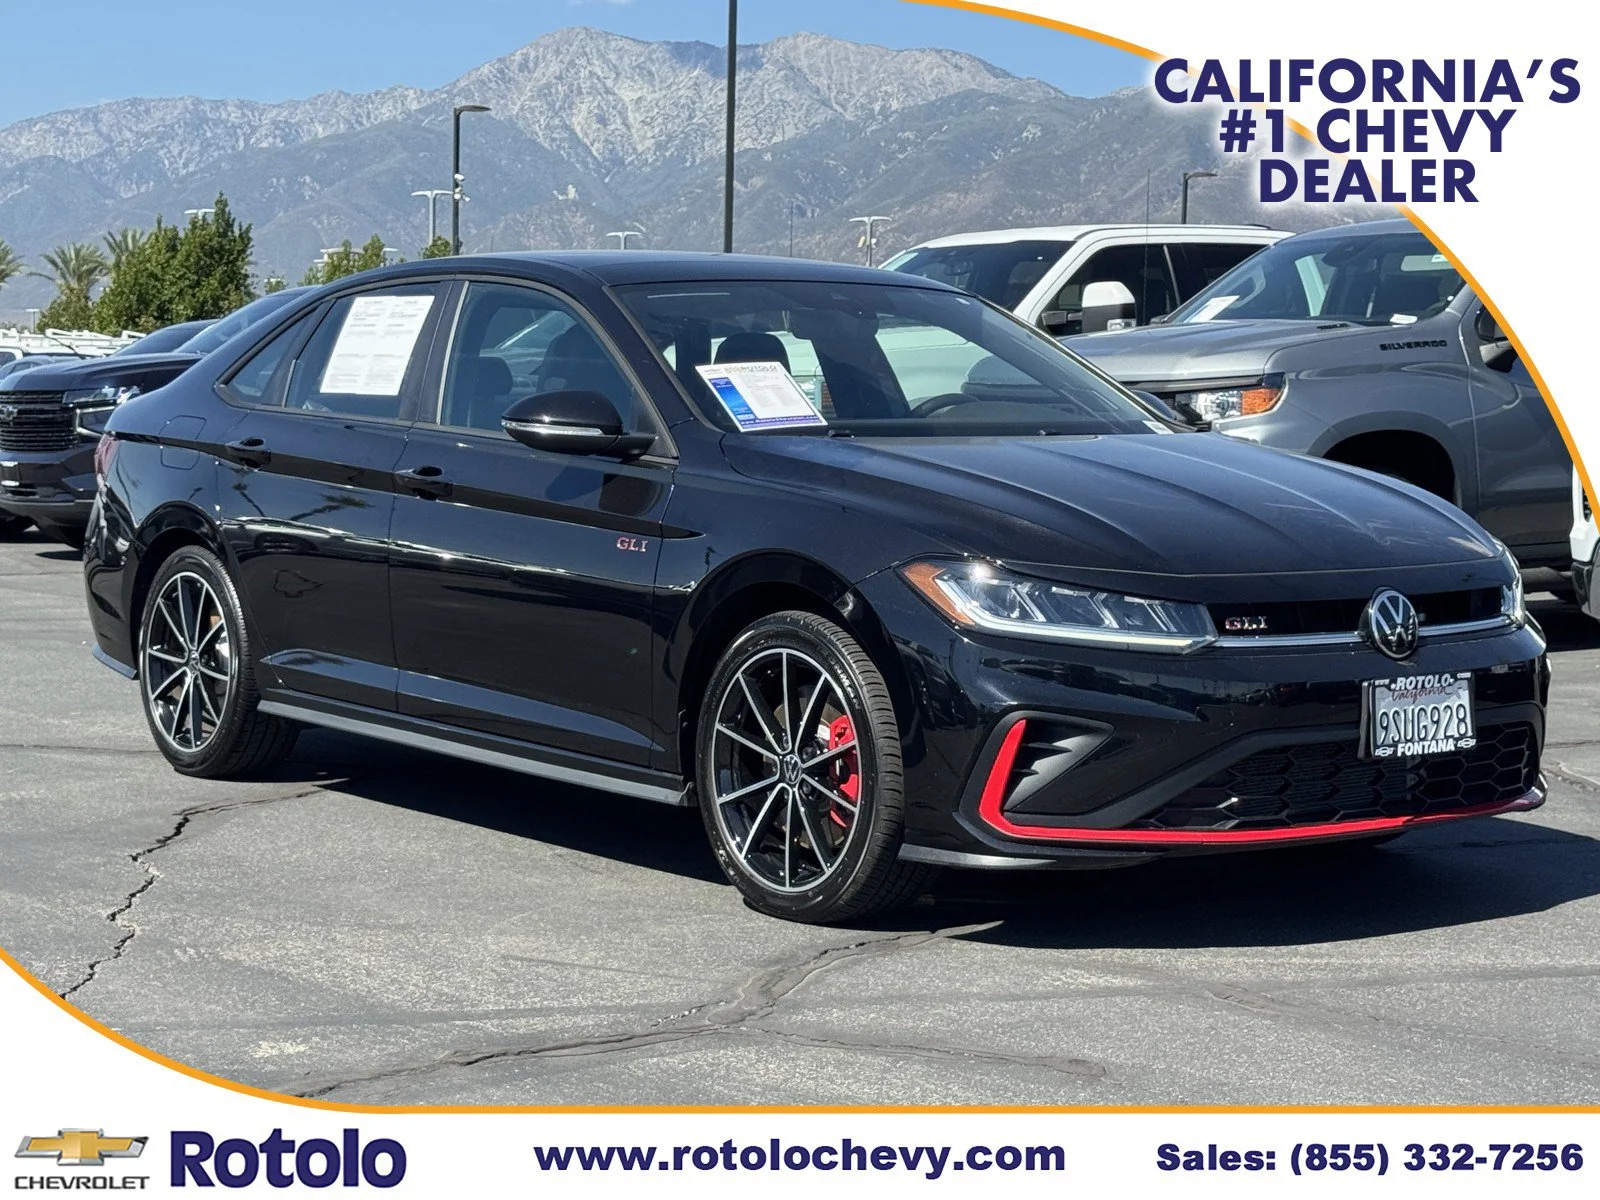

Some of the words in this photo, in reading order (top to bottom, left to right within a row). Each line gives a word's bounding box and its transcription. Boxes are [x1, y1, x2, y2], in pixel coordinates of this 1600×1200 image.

[1379, 339, 1448, 352] SILVERADO
[616, 536, 649, 553] GLI
[1224, 615, 1268, 631] GLI
[1395, 673, 1452, 691] ROTOLO
[1378, 701, 1468, 746] 9SUG928
[1396, 738, 1456, 757] FONTANA
